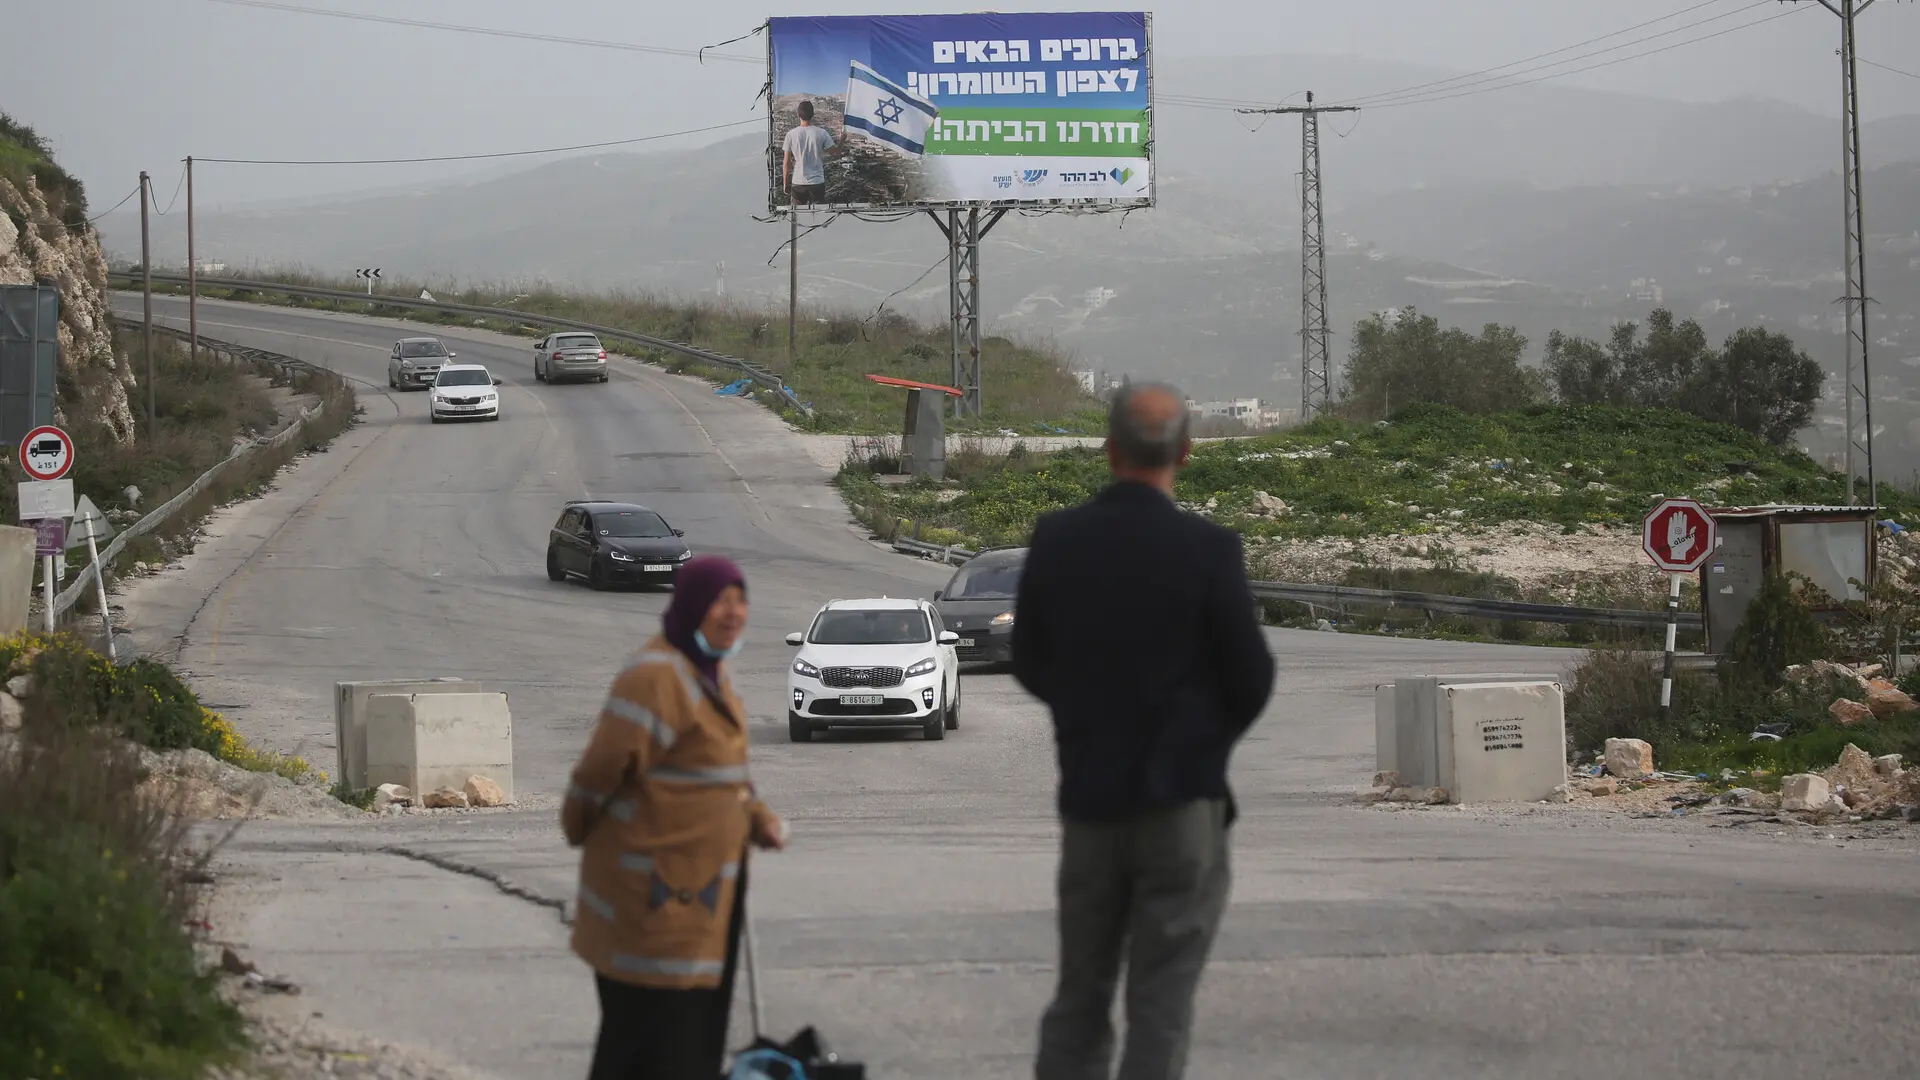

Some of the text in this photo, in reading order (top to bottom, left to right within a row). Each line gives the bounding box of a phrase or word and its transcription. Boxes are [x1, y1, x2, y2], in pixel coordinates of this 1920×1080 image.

[933, 38, 1138, 63] ברוכים הבאים
[907, 68, 1139, 99] לצפון השומרון!
[933, 117, 1140, 143] חזרנו הביתה!
[1060, 170, 1106, 182] לב ההר
[44, 461, 52, 469] 15
